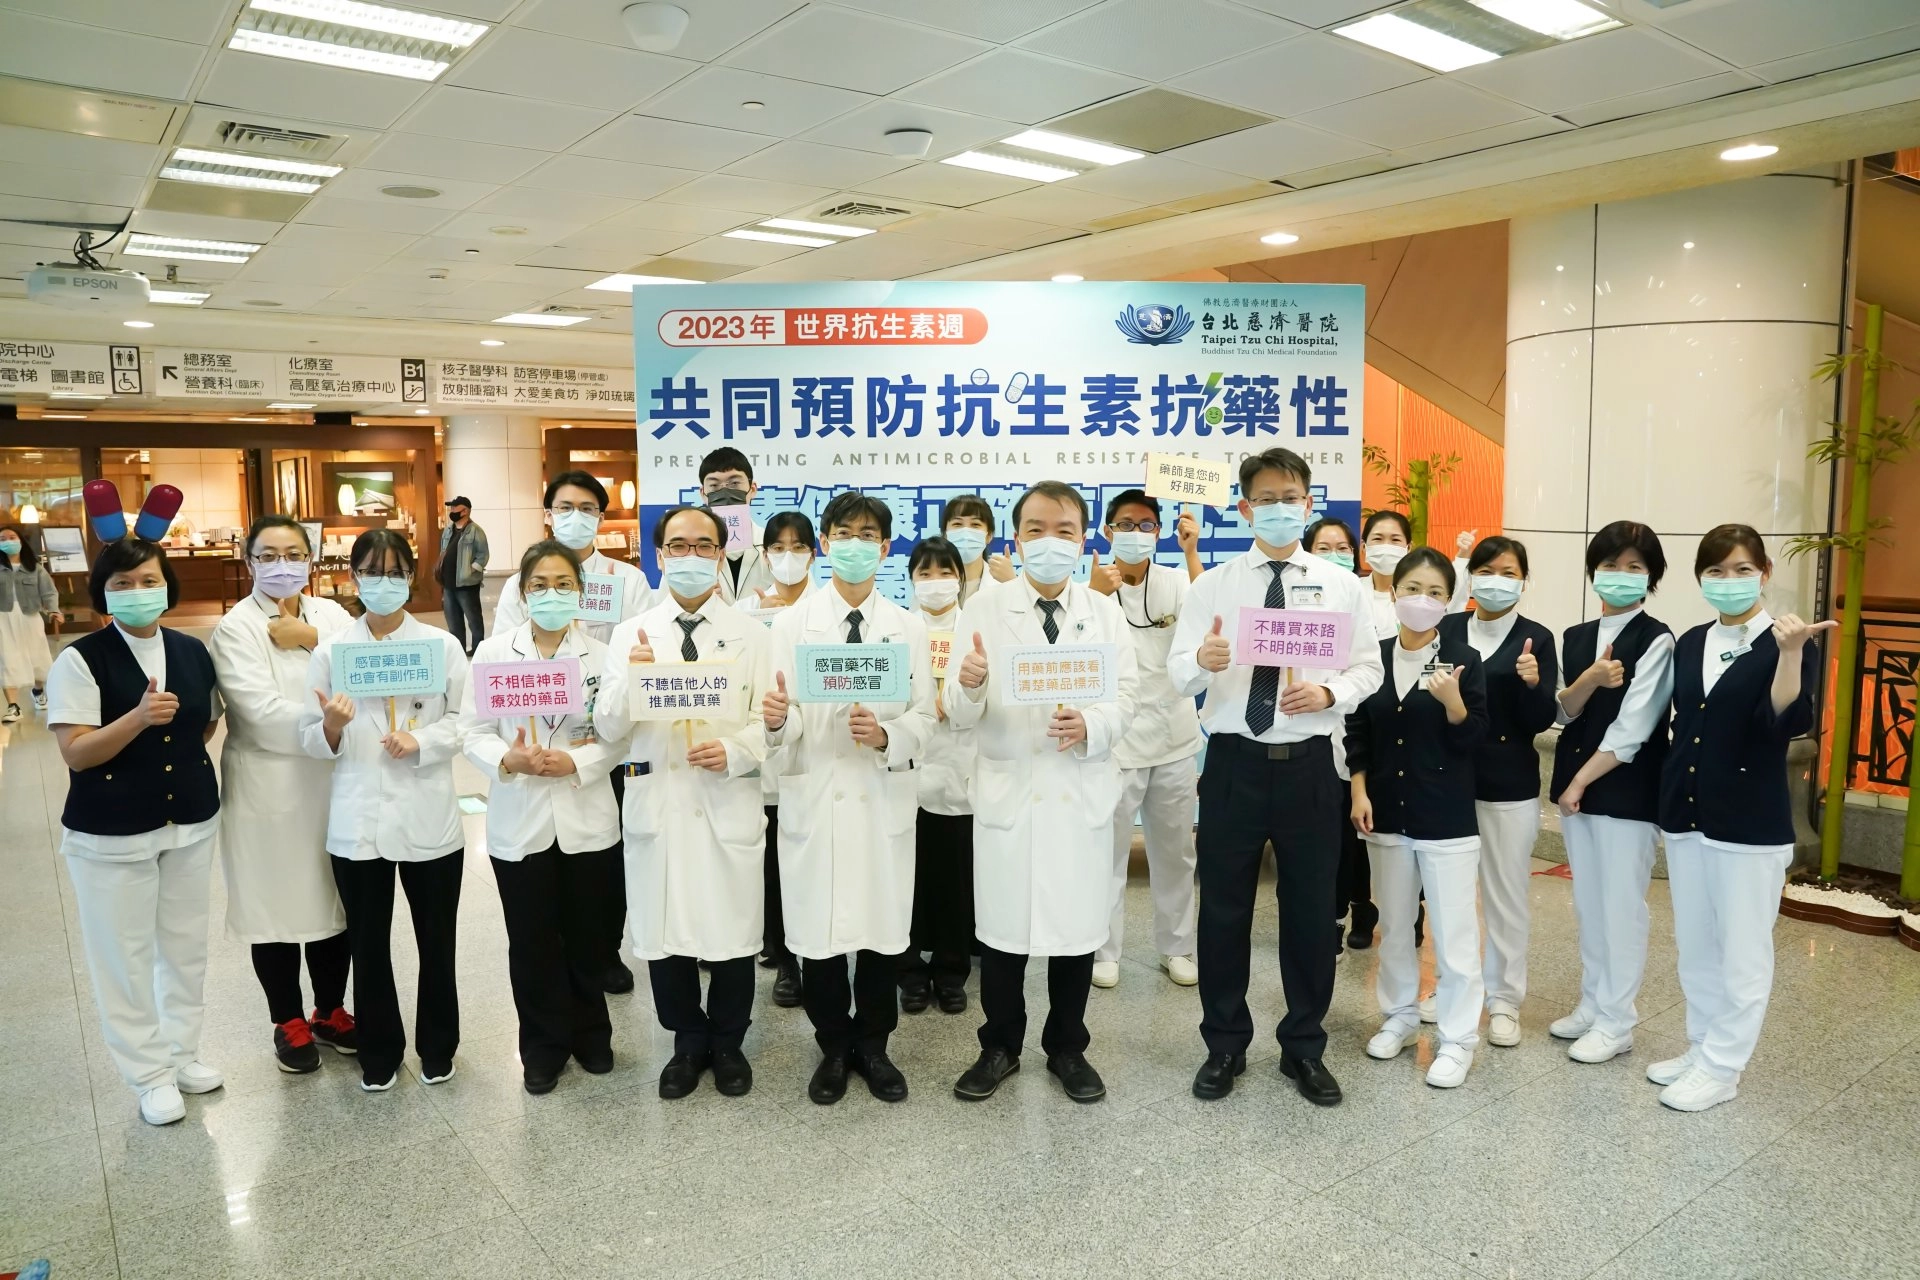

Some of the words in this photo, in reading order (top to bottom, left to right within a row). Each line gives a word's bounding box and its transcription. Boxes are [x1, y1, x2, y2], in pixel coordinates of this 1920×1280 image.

[73, 277, 118, 290] EPSON
[1203, 298, 1299, 308] 佛教慈濟醫療財團法人
[678, 314, 776, 339] 2023年
[794, 313, 964, 340] 世界抗生素週
[1202, 311, 1339, 332] 台北慈濟醫院
[1201, 335, 1236, 346] Taipei
[1240, 335, 1261, 344] Tzu
[1265, 336, 1284, 344] Chi
[1288, 336, 1338, 347] Hospital,
[0, 343, 55, 358] 院中心
[183, 353, 232, 367] 總務室
[289, 357, 333, 371] 化療室
[0, 368, 38, 382] 電梯
[51, 369, 105, 384] 圖書館
[404, 363, 424, 378] B1
[442, 363, 508, 377] 核子醫學科
[289, 378, 396, 394] 高壓氧治療中心
[442, 383, 508, 397] 放射腫瘤科
[514, 386, 579, 400] 大愛美食坊
[649, 373, 1349, 440] 共同預防抗生素抗藥性
[654, 453, 807, 468] PRETING
[832, 452, 1031, 467] ANTIMICROBIAL
[1056, 451, 1200, 465] RESISTAE
[1225, 451, 1344, 466] TOHER
[1159, 463, 1221, 483] 藥師是您的
[1170, 479, 1207, 496] 好朋友
[583, 582, 613, 596] 醫師
[1253, 619, 1336, 638] 不購買來路
[1253, 638, 1335, 657] 不明的藥品
[354, 653, 422, 669] 感冒藥過量
[814, 656, 890, 673] 感冒藥不能
[1018, 659, 1100, 676] 用藥前應該看
[349, 668, 429, 686] 也會有副作用
[489, 671, 567, 691] 不相信神奇
[640, 676, 728, 692] 不聽信他人的
[822, 674, 883, 691] 預防感冒
[1018, 676, 1101, 693] 清楚藥品標示
[490, 690, 569, 709] 療效的藥品
[648, 693, 722, 709] 推薦亂買藥
